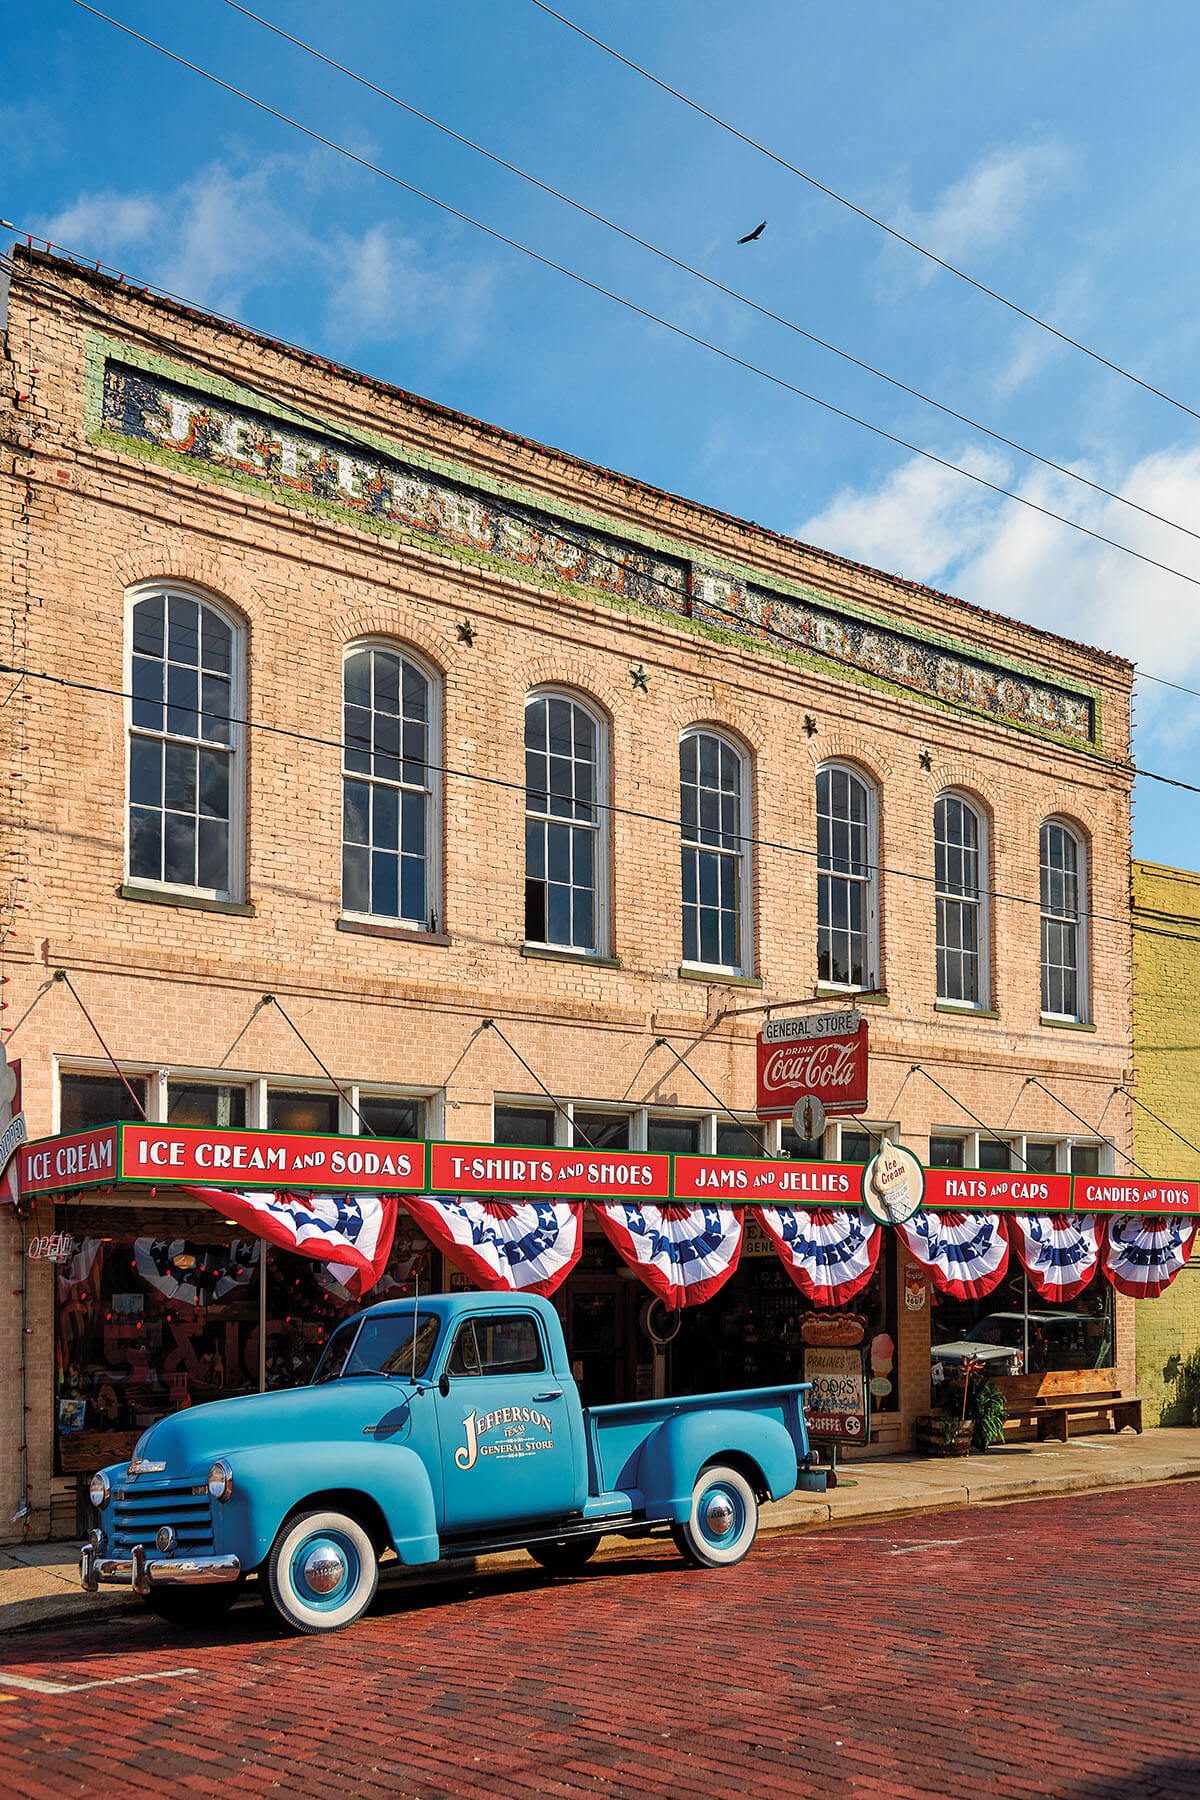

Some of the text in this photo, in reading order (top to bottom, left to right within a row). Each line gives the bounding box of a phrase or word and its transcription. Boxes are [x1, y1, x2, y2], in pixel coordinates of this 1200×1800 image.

[145, 391, 624, 585] JEFFERSON
[766, 1015, 853, 1039] GENERAL STORE
[785, 1045, 814, 1056] DRINK
[763, 1041, 860, 1091] Coca-Cola
[27, 1138, 113, 1182] ICE CREAM
[138, 1139, 412, 1177] ICE CREAM AND SODAS
[884, 1160, 898, 1172] Ice
[451, 1157, 653, 1186] T-SHIRTS AND SHOES
[695, 1167, 850, 1193] JAMS AND JELLIES
[881, 1165, 905, 1185] Cream
[945, 1179, 1049, 1200] HATS AND CAPS
[1086, 1185, 1189, 1205] CANDIES AND TOYS
[28, 1233, 68, 1259] OPEN
[806, 1355, 846, 1369] PRALINES
[454, 1406, 553, 1471] JEFFERSON
[480, 1440, 554, 1456] GENERAL STORE
